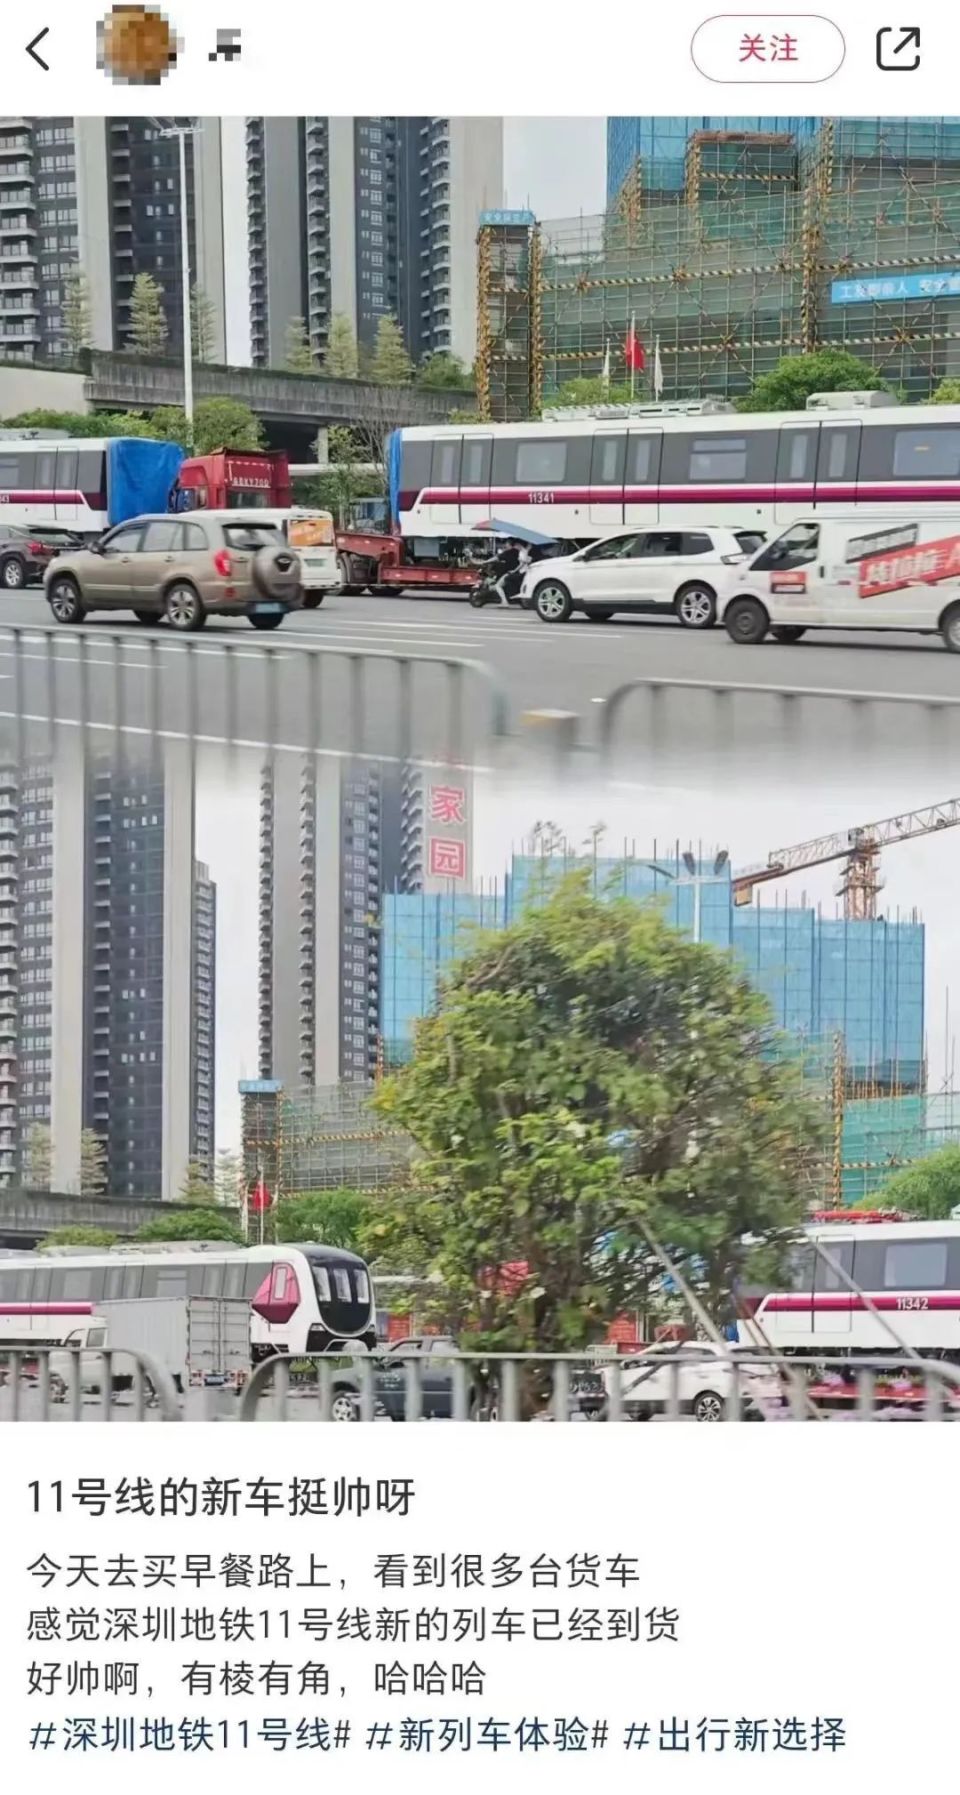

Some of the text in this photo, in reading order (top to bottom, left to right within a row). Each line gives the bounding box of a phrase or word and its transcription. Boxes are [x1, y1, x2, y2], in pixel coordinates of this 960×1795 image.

[528, 491, 555, 504] 11341
[430, 785, 466, 880] 家园
[896, 1297, 929, 1310] 11342
